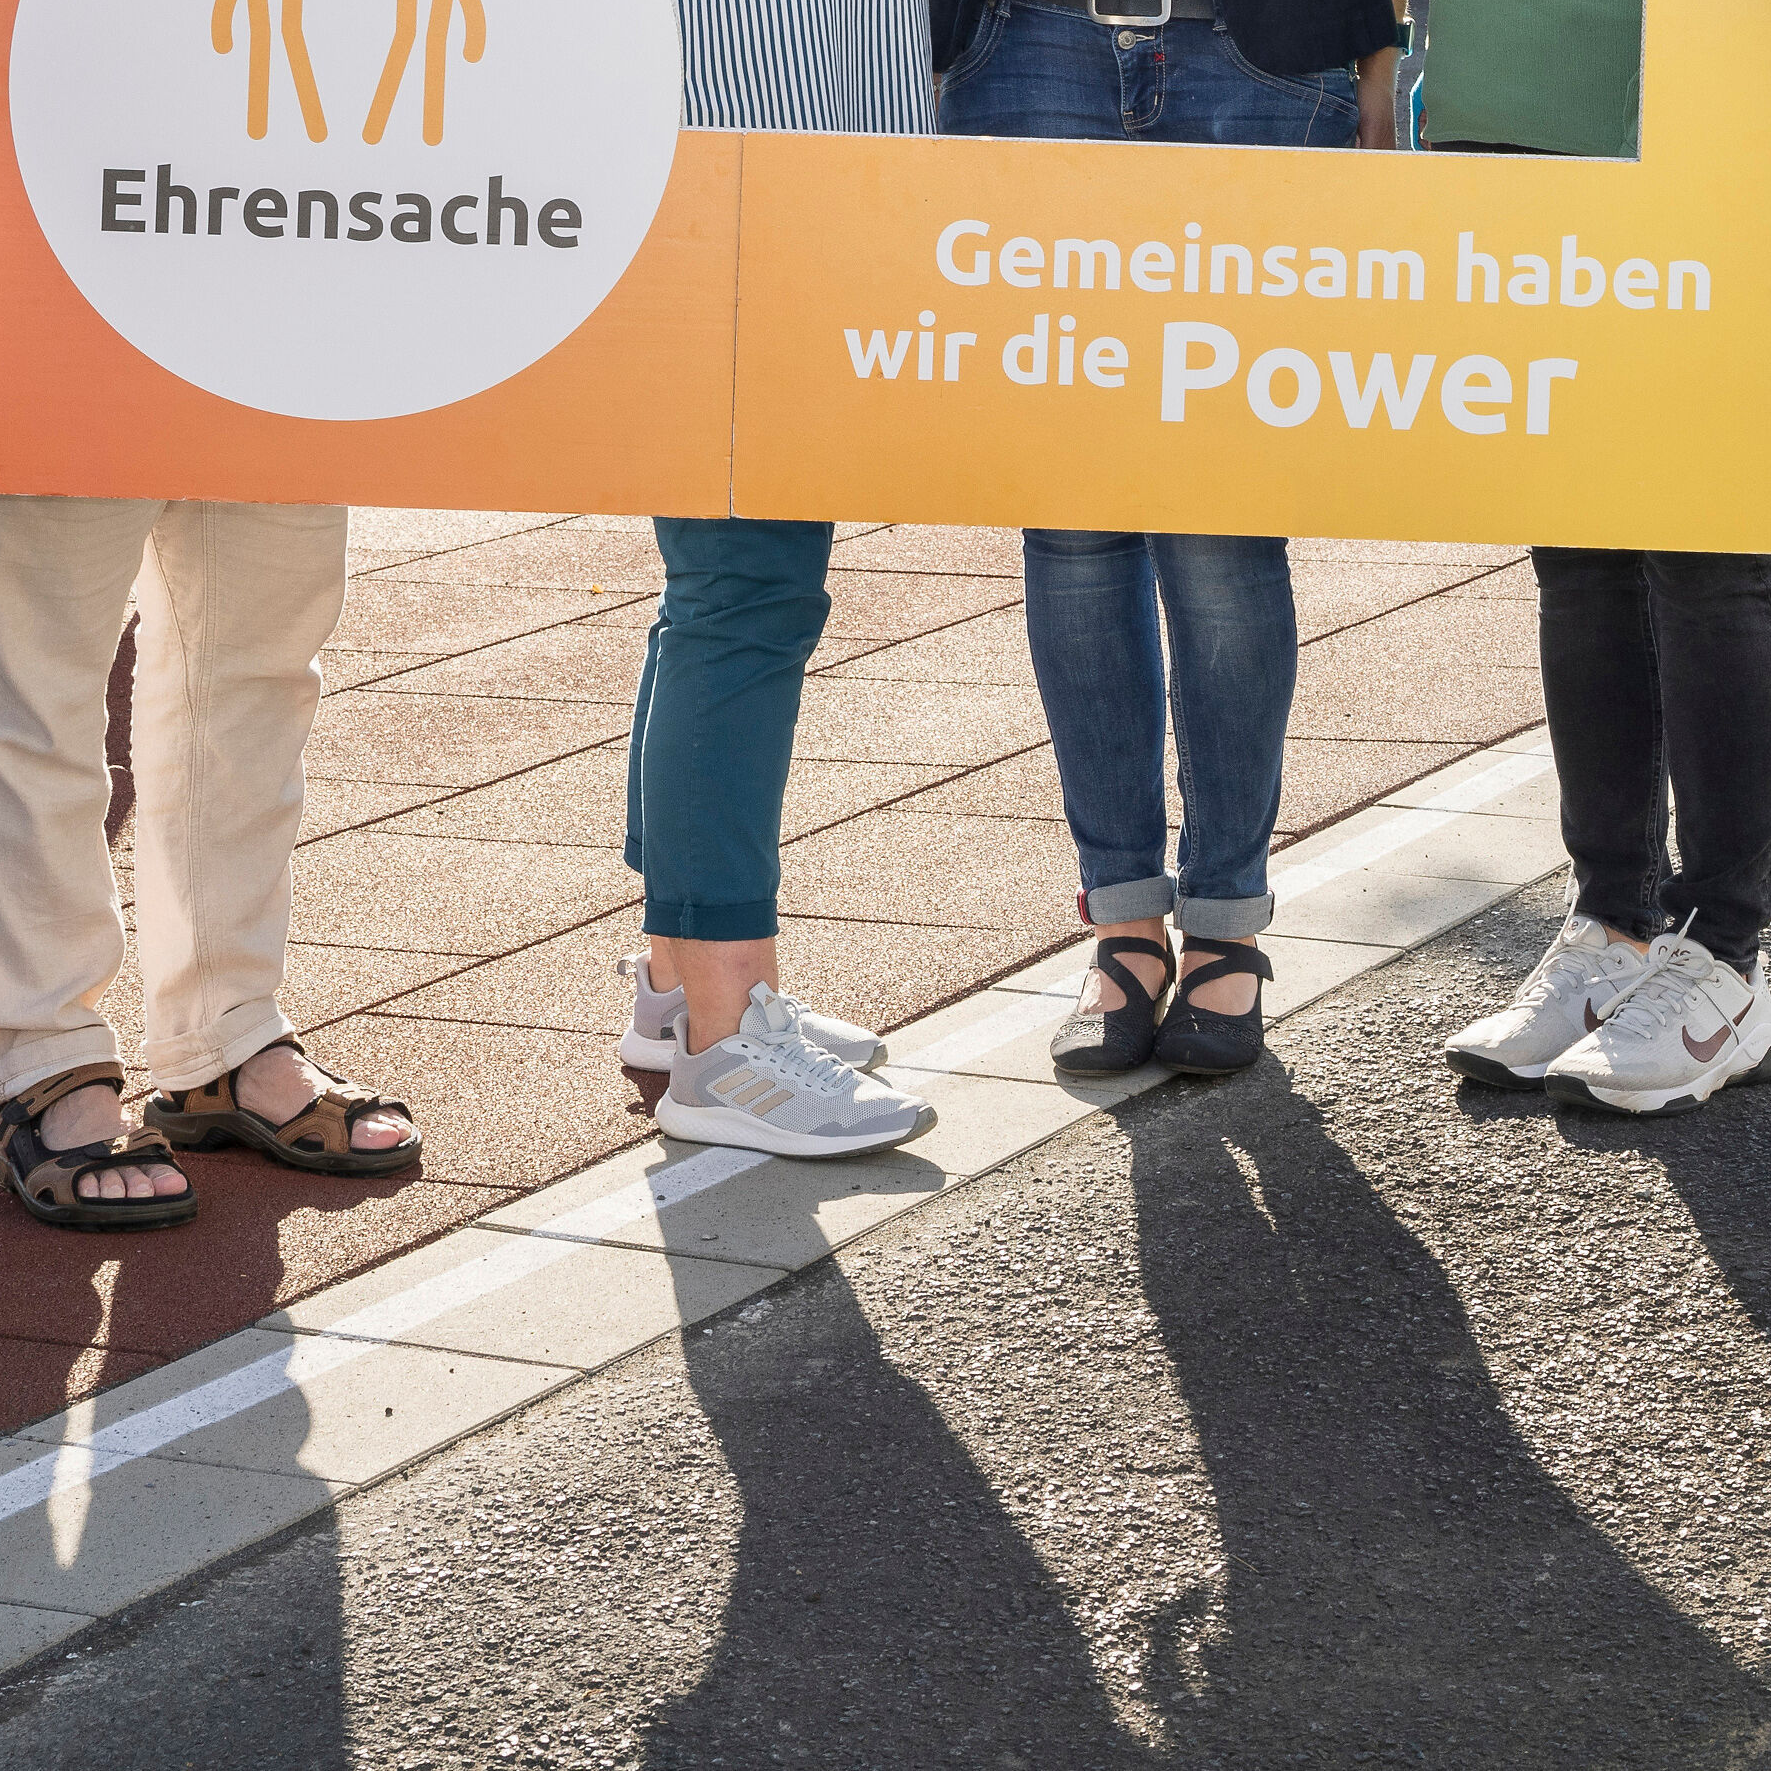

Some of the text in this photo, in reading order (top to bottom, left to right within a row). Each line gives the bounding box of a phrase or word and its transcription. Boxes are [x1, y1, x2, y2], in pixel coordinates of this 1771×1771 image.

[100, 163, 583, 249] Ehrensache
[935, 219, 1712, 312] Gemeinsam haben
[843, 309, 1580, 436] wir die Power
